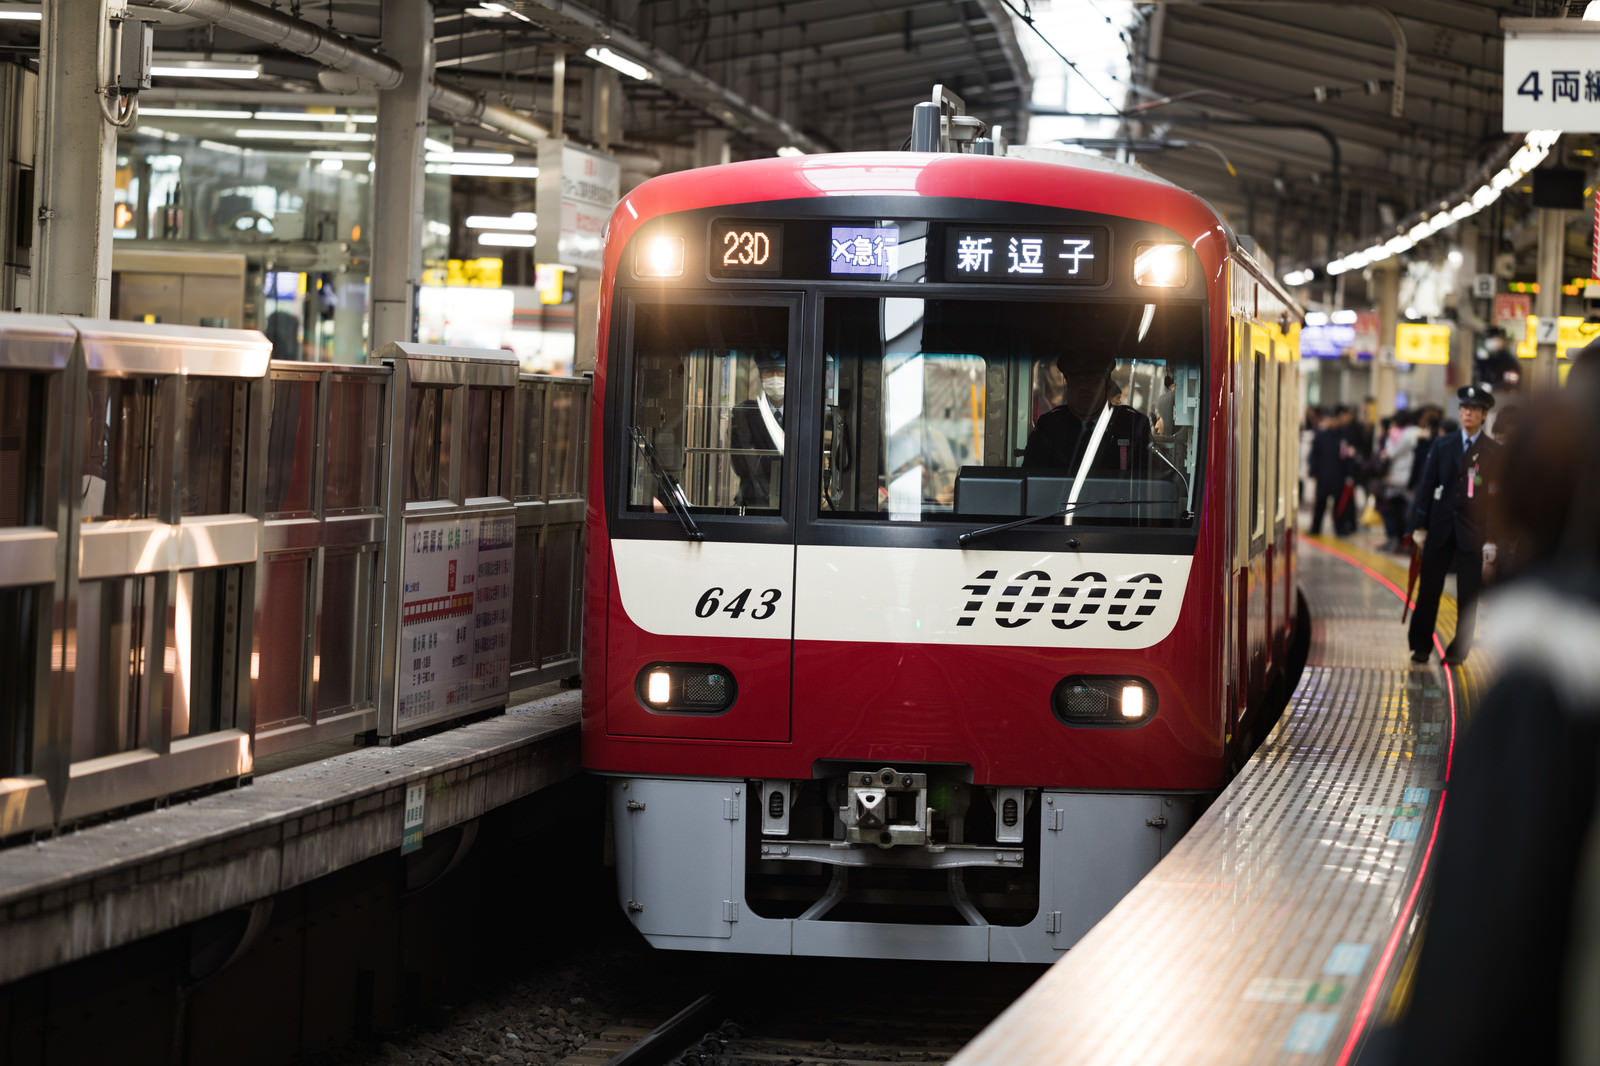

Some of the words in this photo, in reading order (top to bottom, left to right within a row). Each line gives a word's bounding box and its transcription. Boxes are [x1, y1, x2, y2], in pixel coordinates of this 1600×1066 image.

[723, 231, 770, 266] 23D
[956, 235, 1095, 275] 新逗子
[1541, 320, 1555, 339] 7
[694, 586, 783, 621] 643
[956, 569, 1164, 631] 1000
